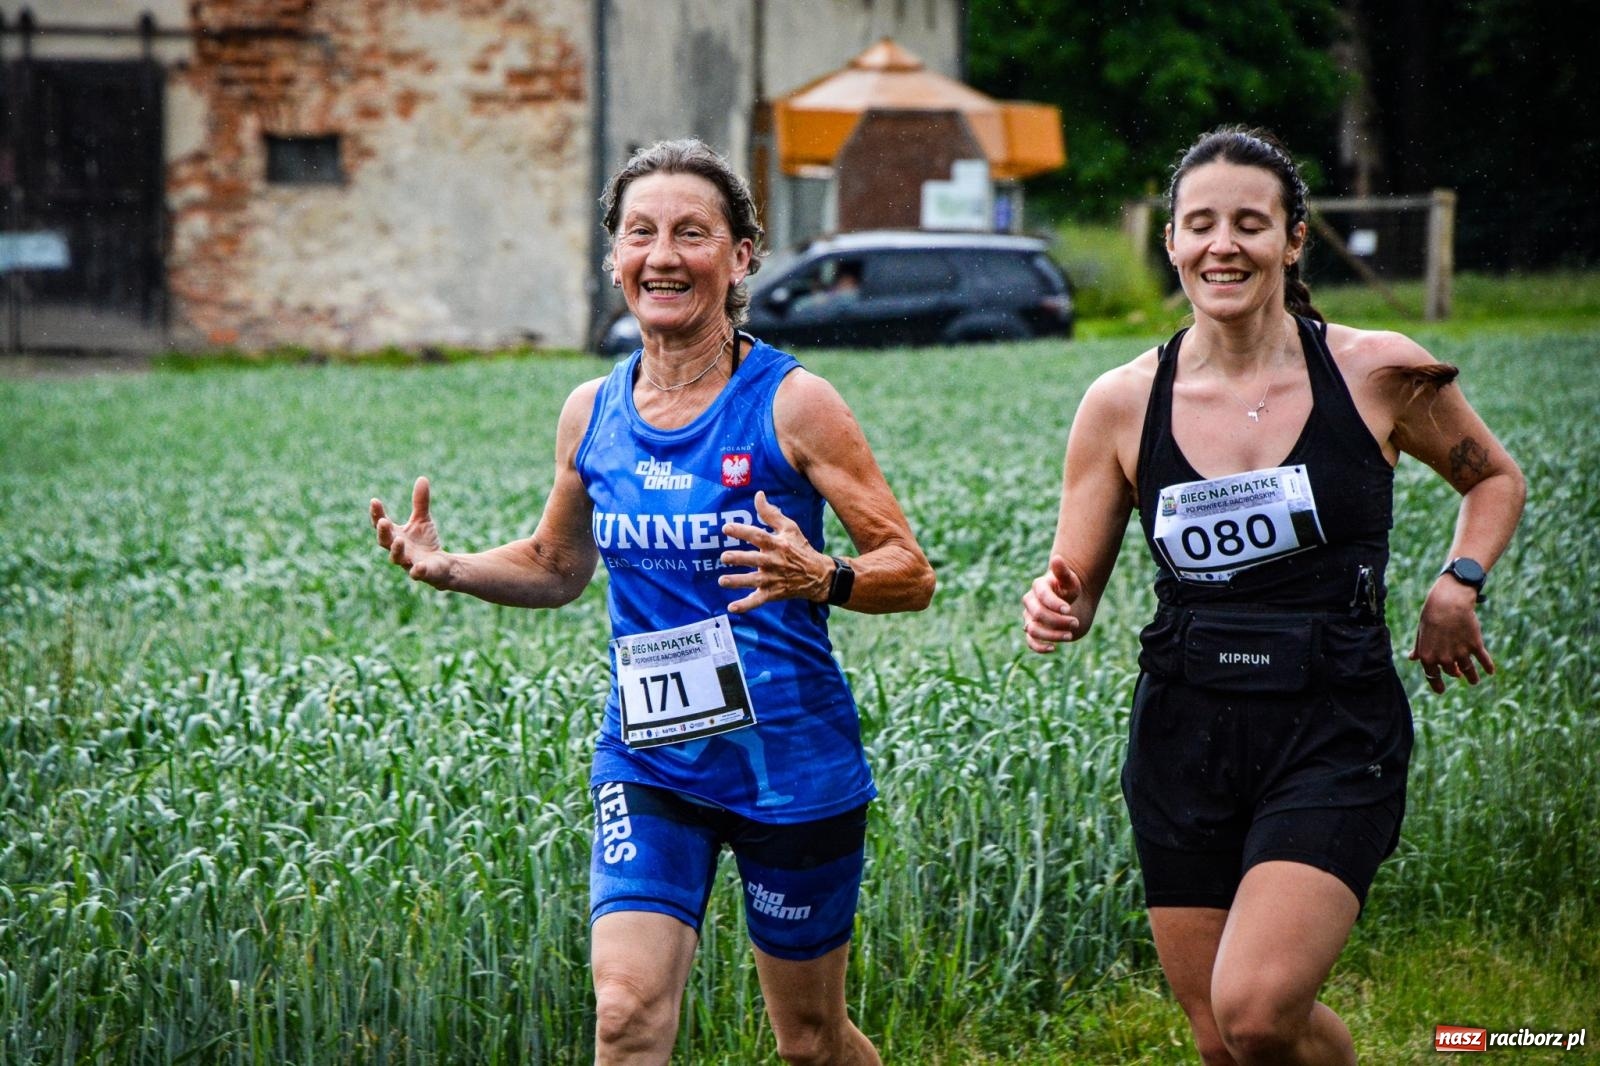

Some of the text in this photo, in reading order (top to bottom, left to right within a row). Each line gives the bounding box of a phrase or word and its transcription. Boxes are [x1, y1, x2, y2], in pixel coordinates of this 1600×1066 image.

[1180, 491, 1207, 504] BIEG
[1209, 487, 1229, 500] NA
[1231, 477, 1279, 495] PIĄTKĘ
[1181, 513, 1277, 561] 080
[692, 559, 736, 572] TEA
[631, 644, 647, 655] BIEG
[647, 641, 660, 652] NA
[660, 633, 703, 651] PIĄTKĘ
[1219, 652, 1270, 665] KIPRUN
[639, 671, 690, 713] 171
